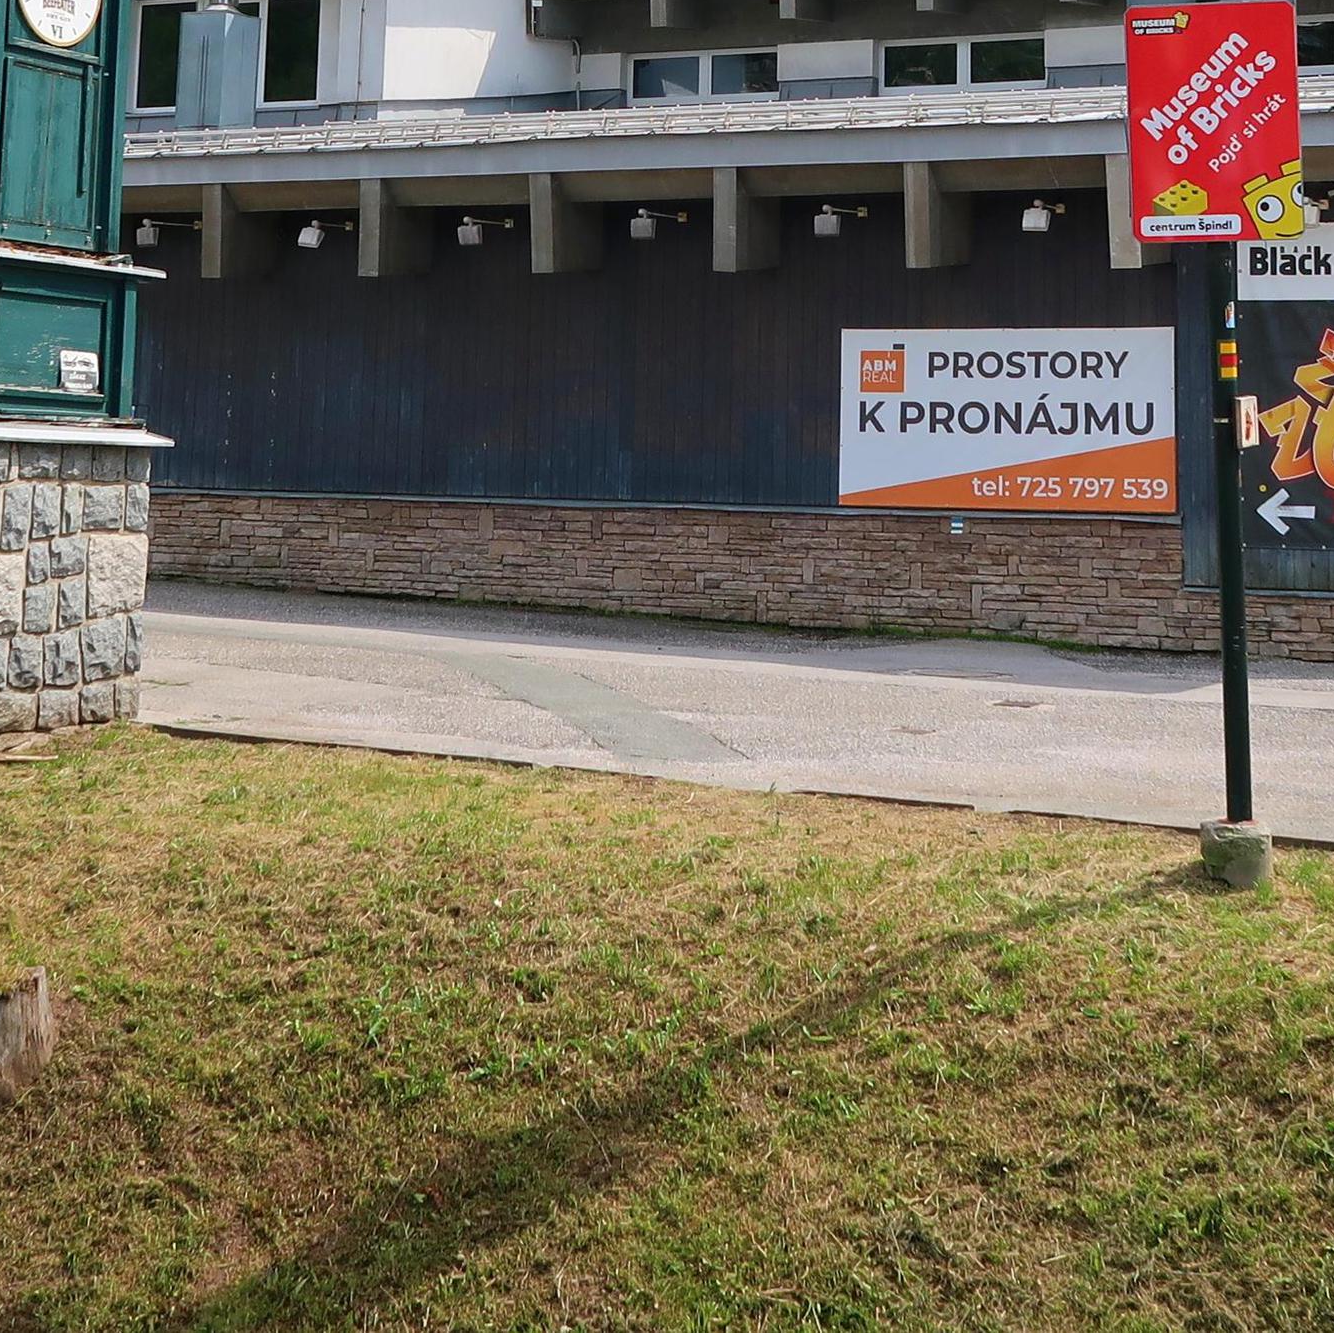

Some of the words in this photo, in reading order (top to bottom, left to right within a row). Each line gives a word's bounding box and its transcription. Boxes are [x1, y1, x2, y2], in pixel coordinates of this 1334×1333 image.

[51, 24, 63, 39] VI
[1131, 18, 1175, 28] MUSEUM
[1140, 32, 1249, 141] Museum
[1167, 124, 1199, 165] of
[1189, 49, 1277, 135] Bricks
[1243, 121, 1259, 139] si
[1258, 93, 1287, 126] hrát
[1149, 221, 1195, 232] centrum
[1198, 218, 1232, 234] Špindl
[1249, 246, 1332, 276] Black
[863, 359, 896, 371] ABM
[863, 371, 896, 383] REAL
[927, 351, 1130, 379] PROSTORY
[859, 401, 885, 433] K
[900, 393, 1154, 435] PRONÁJMU
[971, 476, 1010, 497] tel:
[1017, 477, 1062, 498] 725
[1069, 477, 1115, 499] 797
[1122, 478, 1169, 500] 539
